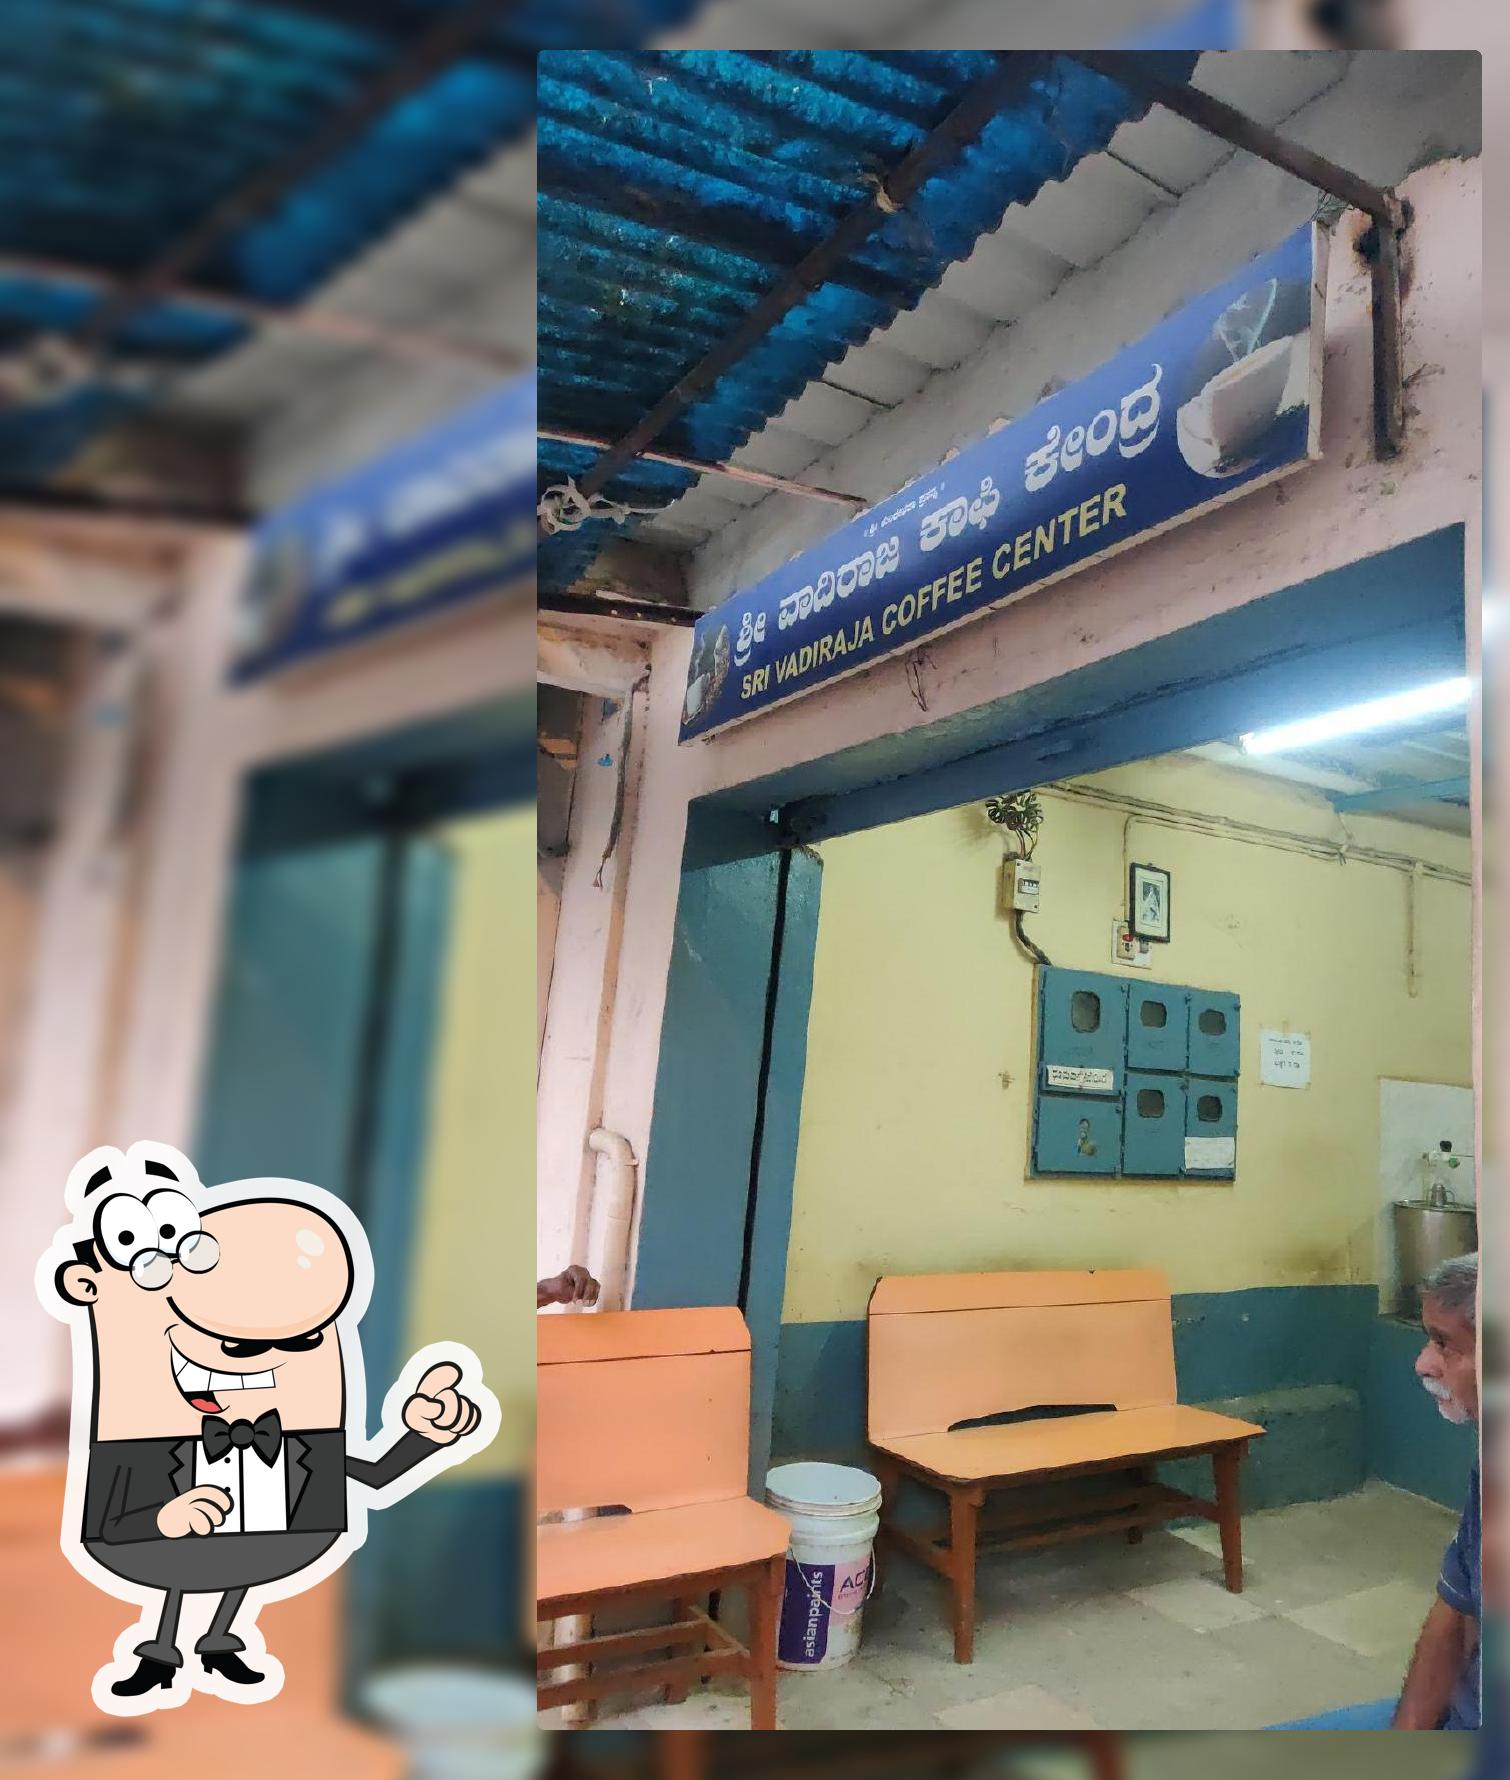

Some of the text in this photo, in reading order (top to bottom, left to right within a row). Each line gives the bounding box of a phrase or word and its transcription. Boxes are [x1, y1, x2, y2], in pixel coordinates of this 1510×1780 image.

[734, 363, 1163, 667] ಶ್ರೀ ವಾದಿರಾಜ ಕಾಫಿ ಕೇಂದ್ರ
[741, 483, 1127, 699] SRI VADIRAJA COFFEE CENTER
[803, 1571, 824, 1658] asianpaints
